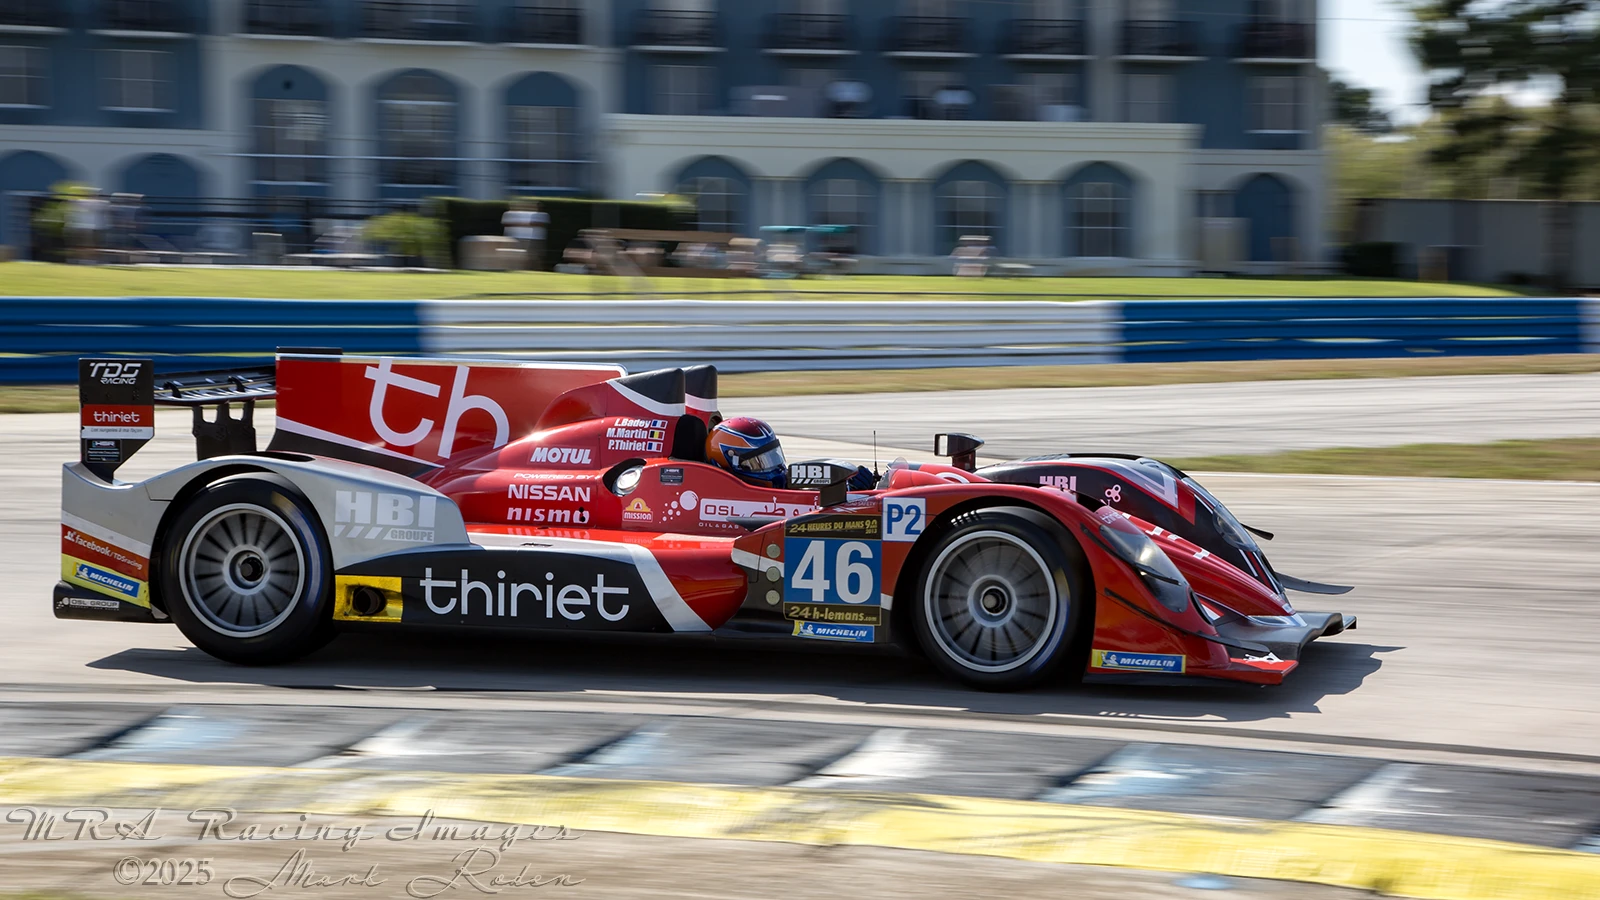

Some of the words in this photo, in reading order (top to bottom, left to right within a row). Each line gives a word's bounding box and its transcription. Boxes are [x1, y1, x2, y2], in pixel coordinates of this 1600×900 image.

[90, 362, 142, 378] TDS
[100, 377, 137, 385] RACING
[364, 358, 510, 460] th
[93, 411, 140, 423] thiriet
[614, 418, 651, 429] L.Badey
[606, 428, 648, 439] M.Martin
[608, 439, 647, 451] P.Thiriet
[530, 447, 592, 464] MOTUL
[513, 472, 575, 480] POWERED
[791, 465, 831, 479] HBI
[508, 484, 591, 502] NISSAN
[335, 490, 437, 528] HBI
[507, 507, 590, 524] nismo
[704, 504, 740, 517] OSL
[886, 503, 922, 536] P2
[789, 523, 807, 533] 24
[807, 522, 833, 531] HEURES
[833, 521, 843, 529] DU
[844, 520, 865, 529] MANS
[390, 529, 433, 541] GROUPE
[791, 540, 874, 604] 46
[89, 572, 134, 591] MICHELIN
[420, 567, 630, 622] thiriet
[816, 627, 868, 637] MICHELIN
[1120, 657, 1176, 667] MICHELIN
